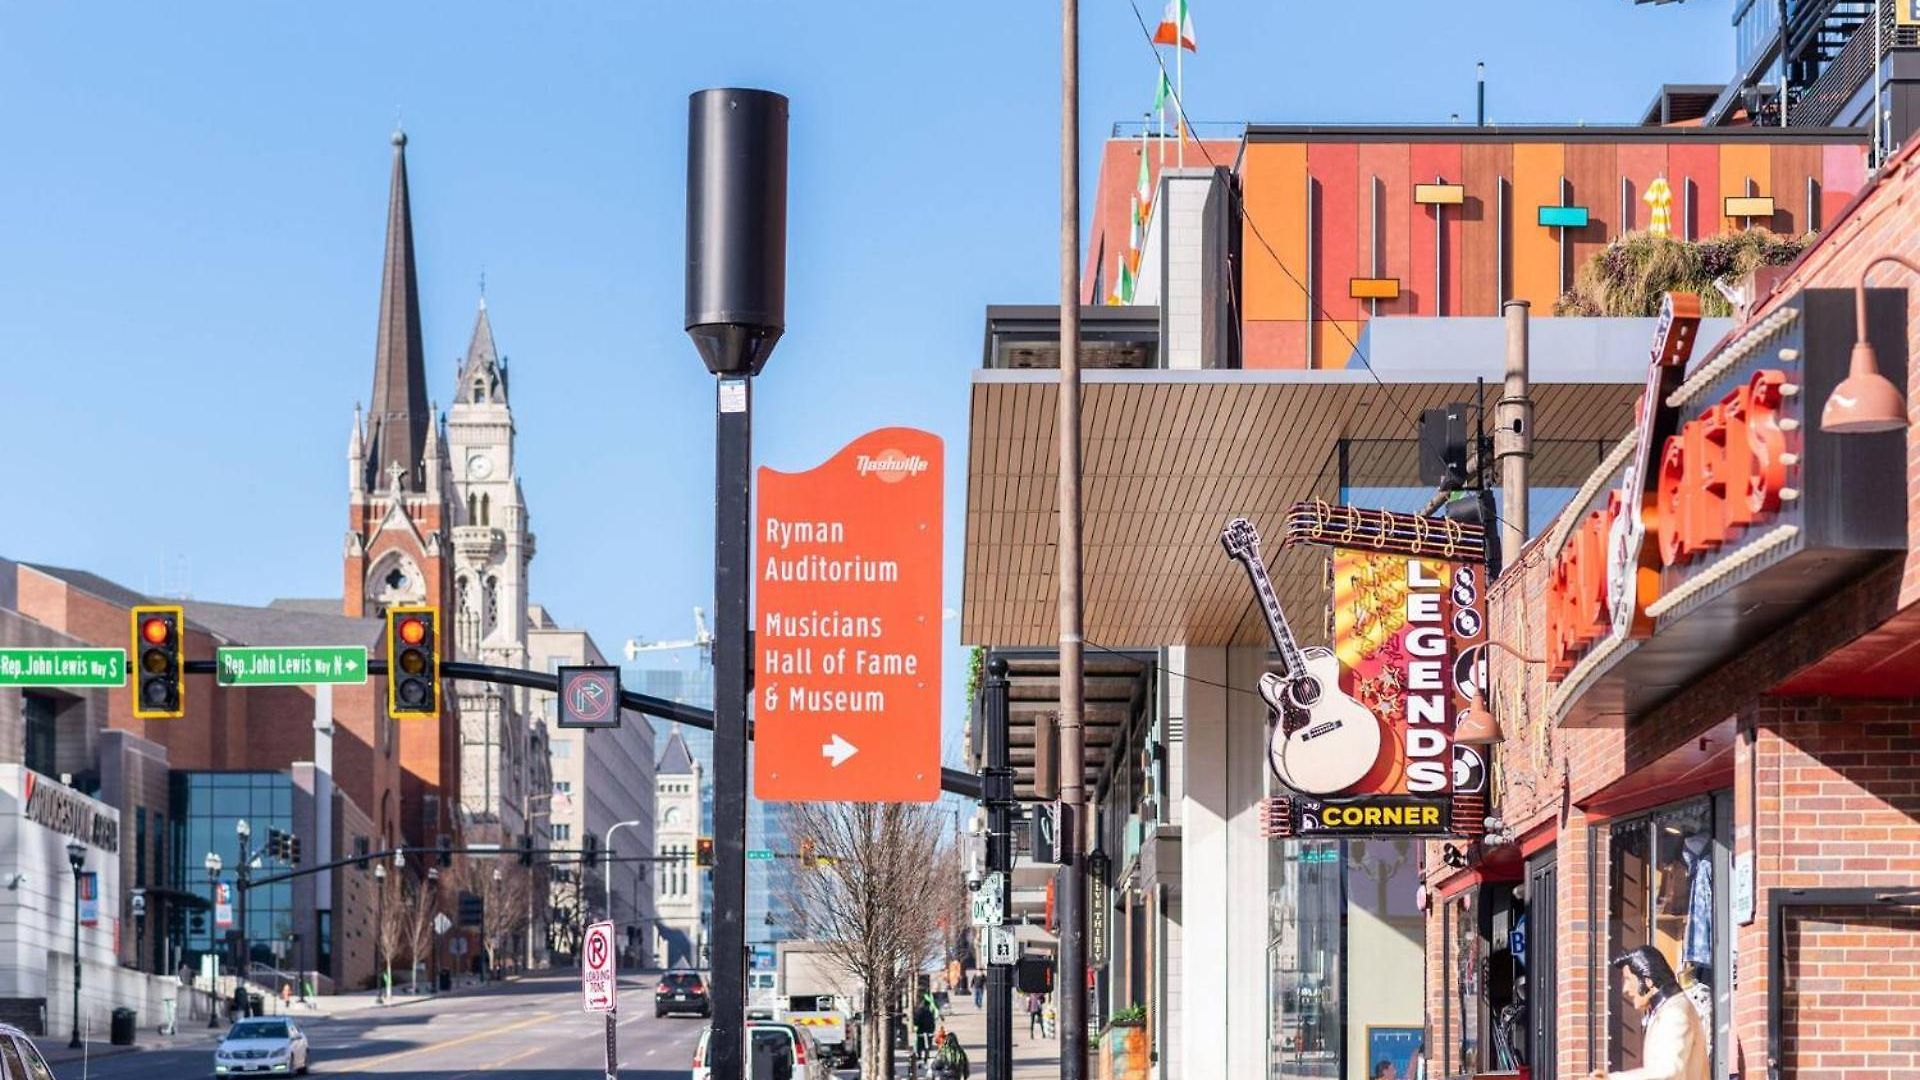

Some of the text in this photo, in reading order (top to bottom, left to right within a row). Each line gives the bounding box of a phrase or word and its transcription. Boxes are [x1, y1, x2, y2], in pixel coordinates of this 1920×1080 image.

[856, 454, 928, 477] Nashville
[766, 517, 844, 549] Ryman
[765, 555, 898, 582] Auditorium
[766, 610, 882, 638] Musicians
[1, 654, 25, 679] Rep.
[26, 654, 52, 676] John
[54, 654, 88, 676] Lewis
[109, 657, 118, 678] S
[224, 653, 247, 679] Rep.
[249, 653, 276, 675] John
[278, 653, 312, 675] Lewis
[333, 655, 343, 676] N
[765, 648, 918, 675] Hall of Fame
[1405, 559, 1448, 793] LEGENDS
[764, 686, 885, 712] & Museum
[1321, 807, 1441, 826] CORNER
[1093, 911, 1103, 962] THIRTY
